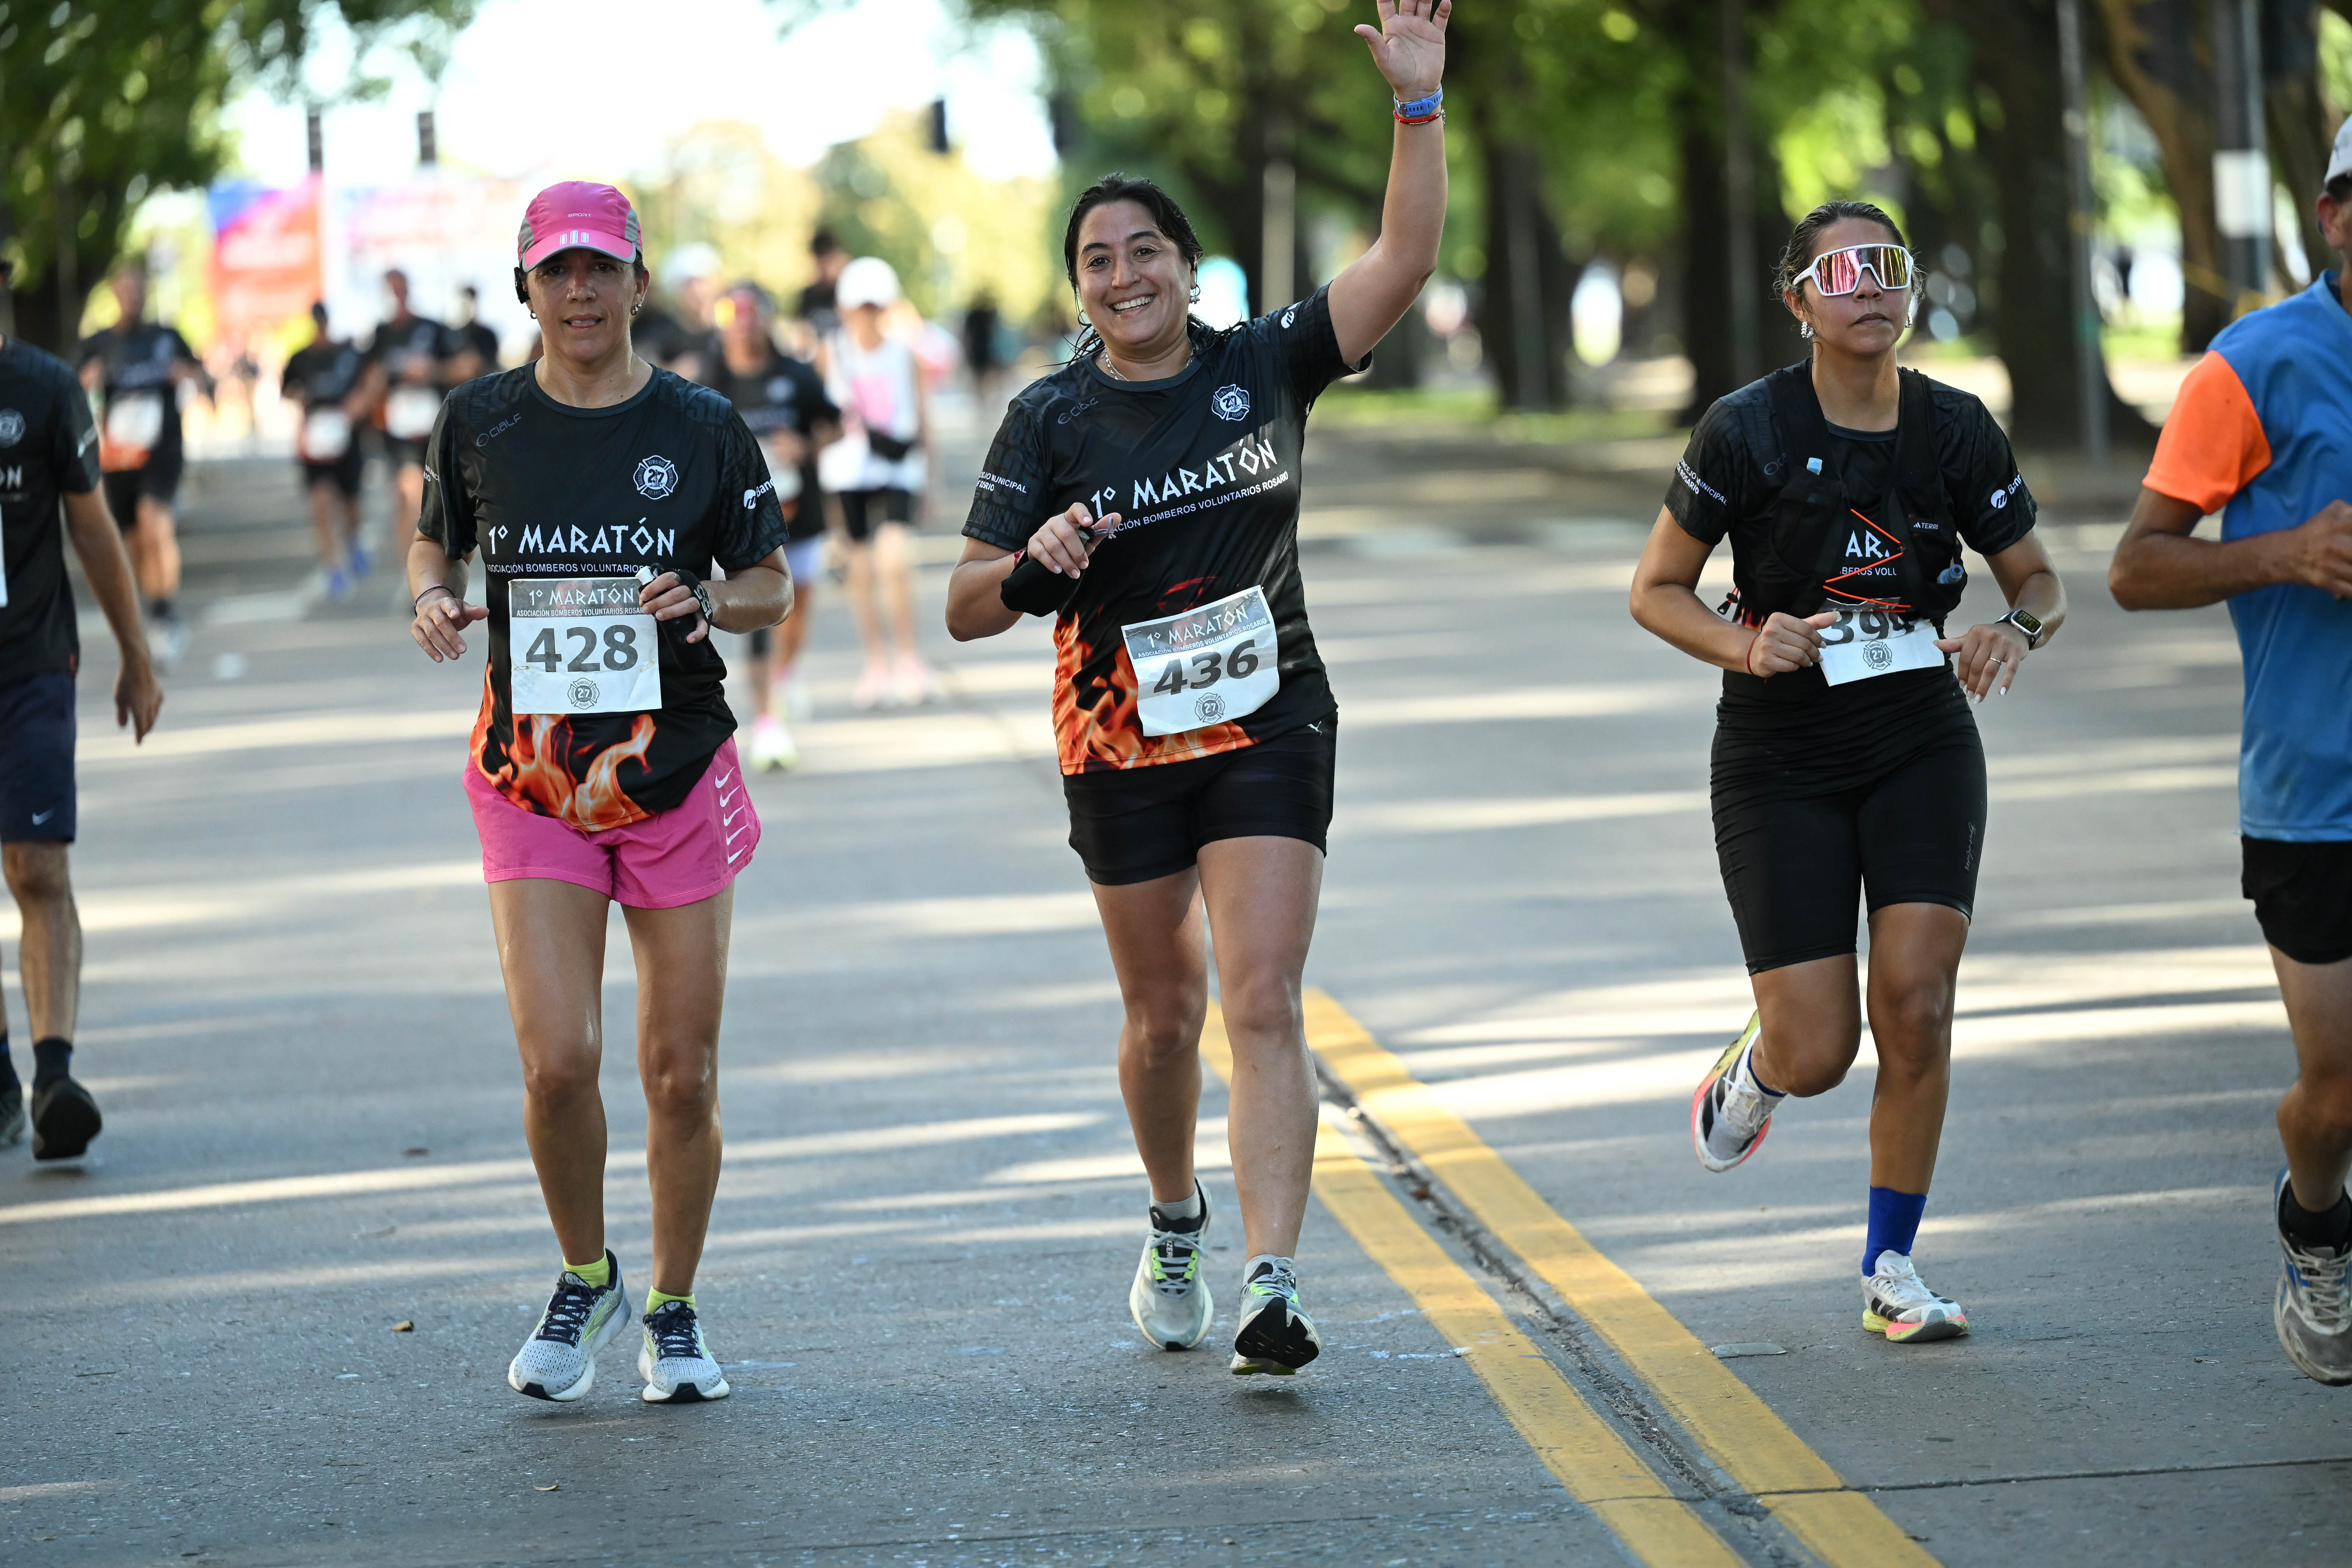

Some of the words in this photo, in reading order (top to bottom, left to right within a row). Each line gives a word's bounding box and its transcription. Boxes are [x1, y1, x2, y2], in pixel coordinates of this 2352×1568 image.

[1222, 395, 1237, 409] 27
[648, 468, 665, 483] 27
[1132, 438, 1278, 509] MARATÓN
[1680, 458, 1696, 480] ONCEJO
[1680, 469, 1699, 494] ROSARIO
[1143, 503, 1197, 525] BOMBEROS
[1199, 484, 1261, 509] VOLUNTARIOS
[1262, 471, 1289, 492] ROSARIO
[518, 517, 675, 557] MARATÓN
[1845, 530, 1890, 558] AR
[526, 564, 578, 572] BOMBEROS
[580, 564, 645, 573] VOLUNTARIOS
[1839, 567, 1872, 576] BEROS
[549, 583, 634, 606] MARATÓN
[516, 608, 550, 617] ASOCIACIÓN
[1168, 605, 1248, 645] MARATÓN
[526, 625, 638, 672] 428
[1138, 648, 1172, 658] ASOCIACIÓN
[1173, 640, 1204, 653] BOMBEROS
[1204, 627, 1242, 646] VOLUNTARIOS
[1242, 618, 1267, 632] ROSARIO
[1871, 649, 1883, 660] 27
[1153, 639, 1259, 695] 436
[578, 687, 590, 699] 27
[1204, 703, 1216, 714] 27
